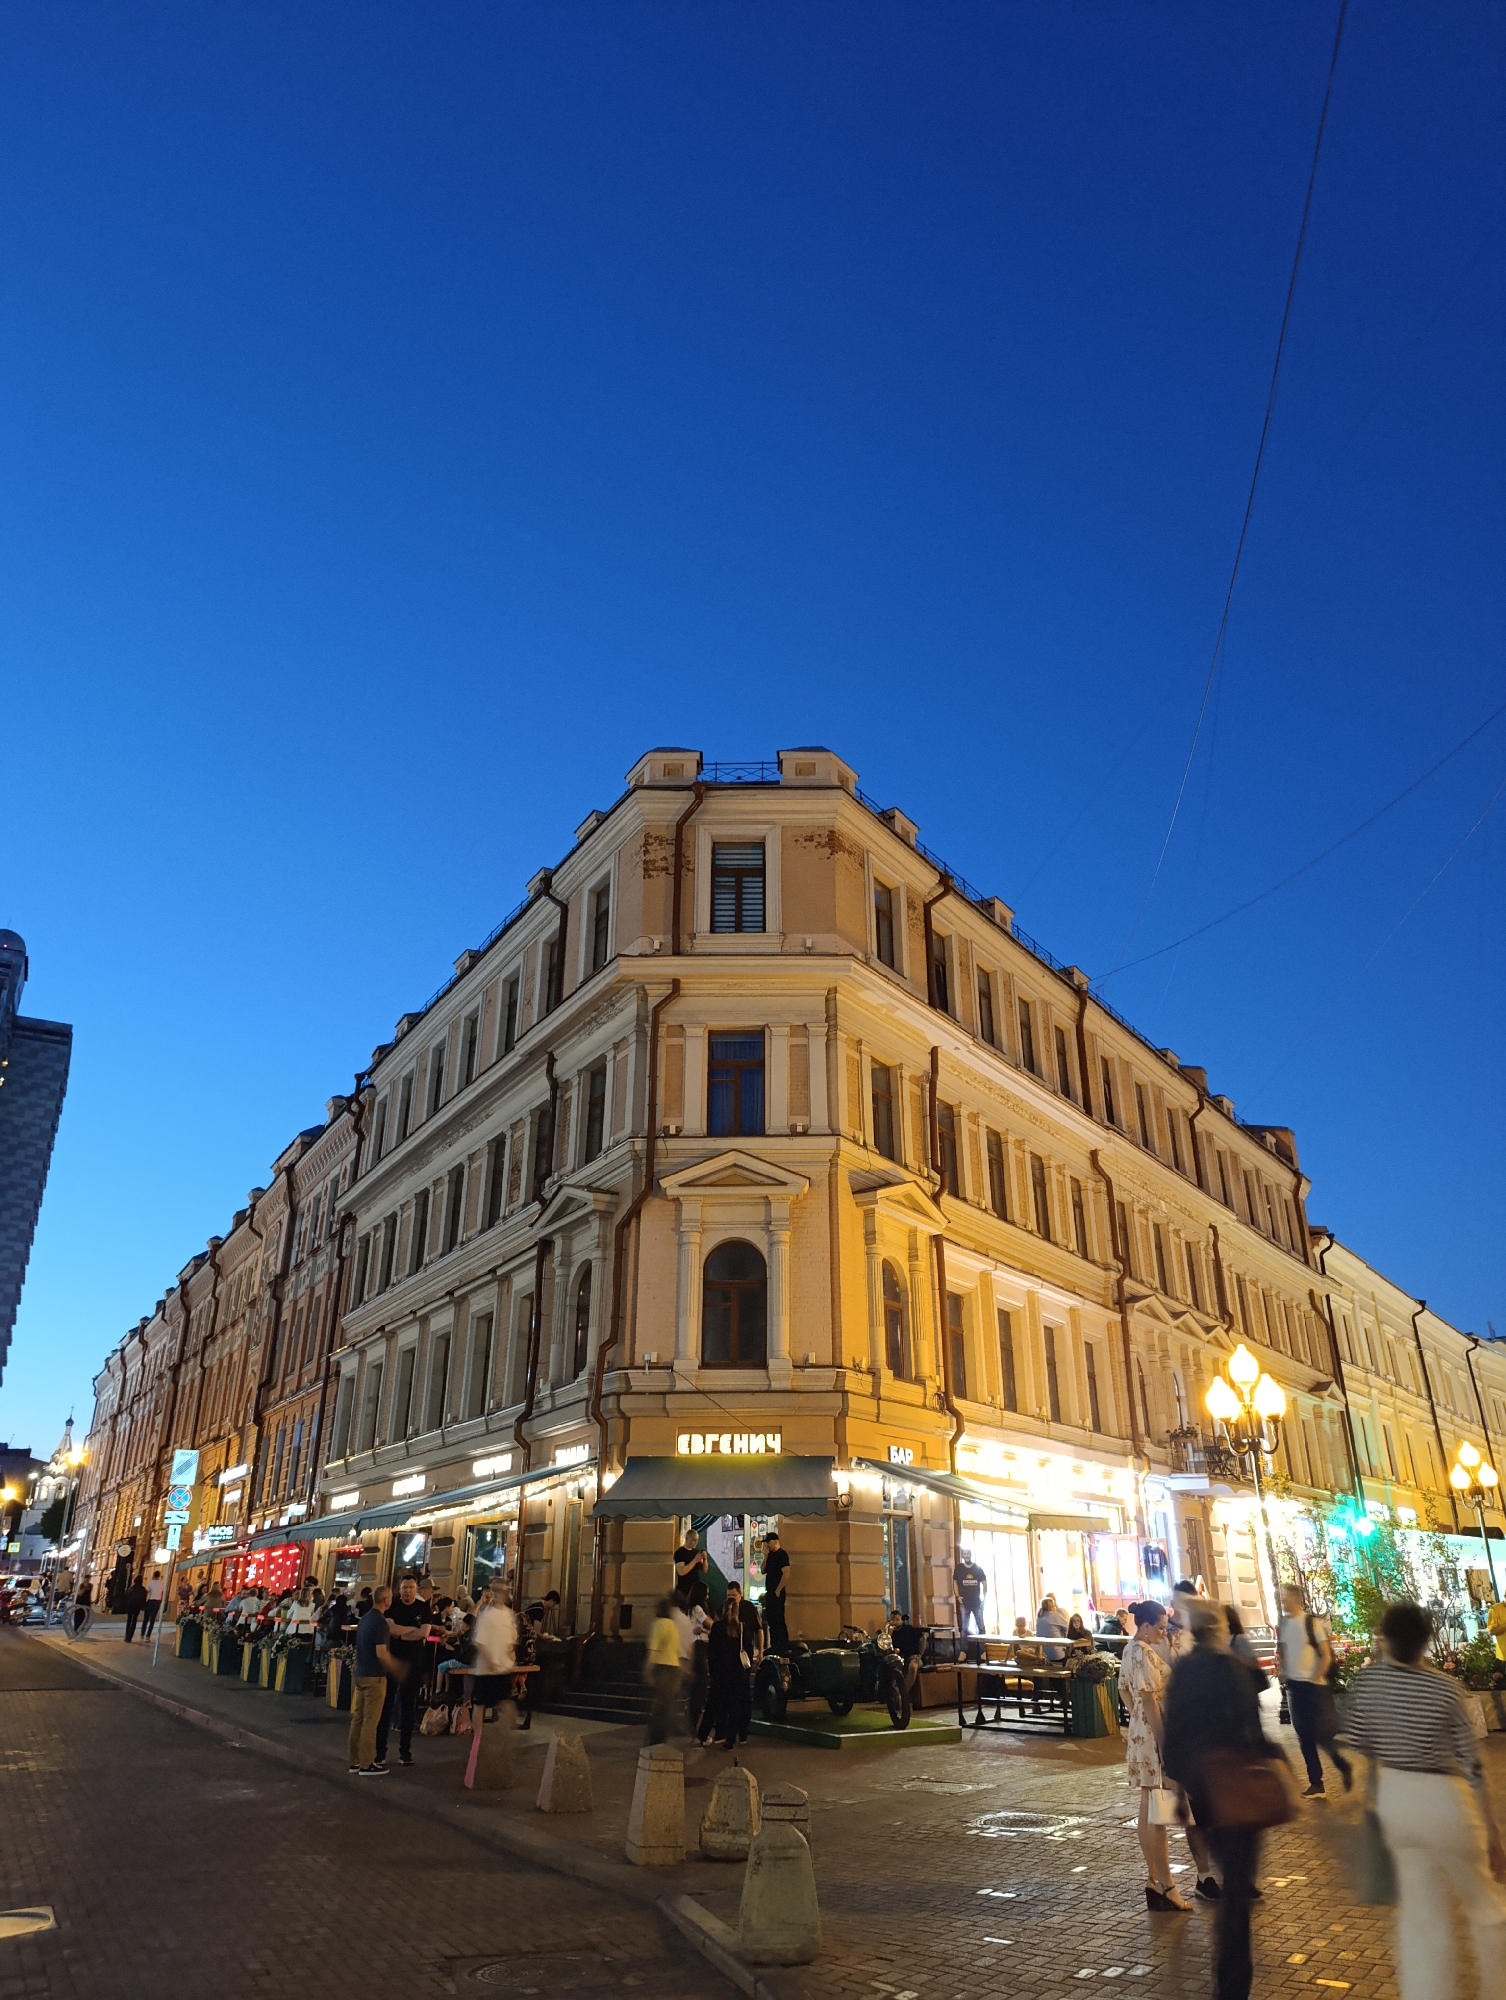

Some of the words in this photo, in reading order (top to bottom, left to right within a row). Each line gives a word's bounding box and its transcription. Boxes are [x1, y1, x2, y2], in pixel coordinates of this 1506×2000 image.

[677, 1433, 782, 1455] ЕВГЕНИЧ
[889, 1446, 914, 1464] БАР
[208, 1525, 233, 1536] MOS
